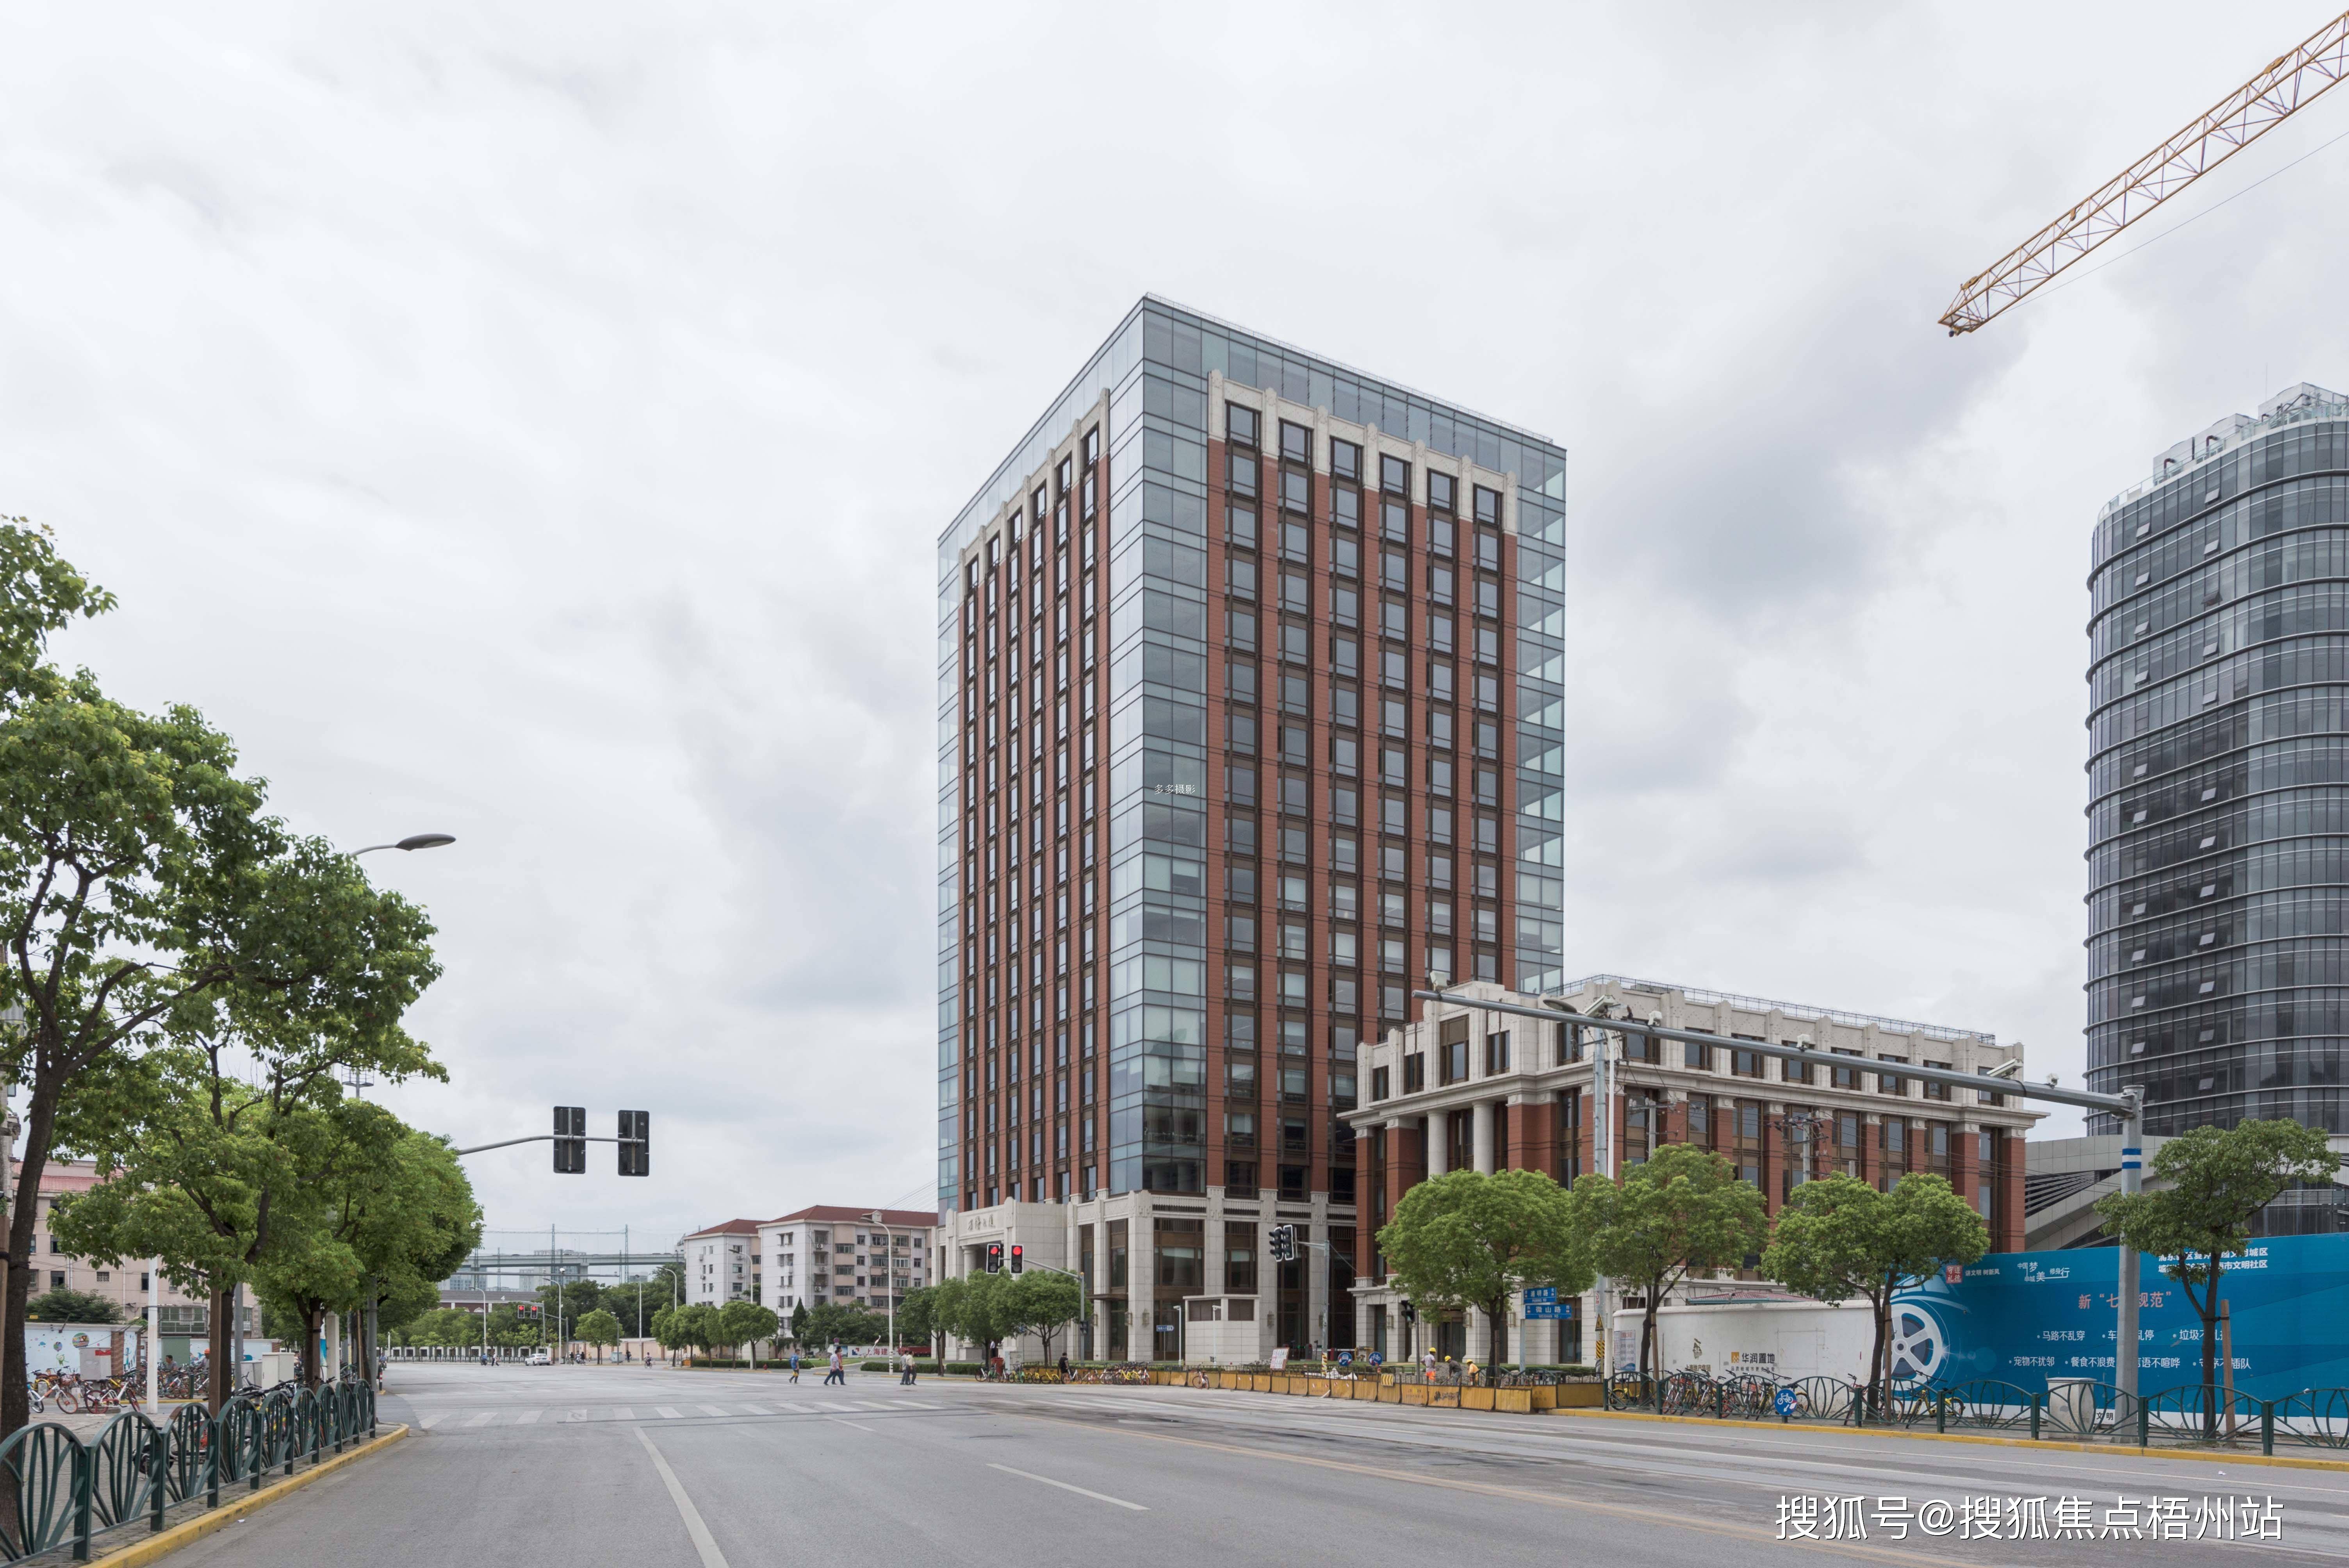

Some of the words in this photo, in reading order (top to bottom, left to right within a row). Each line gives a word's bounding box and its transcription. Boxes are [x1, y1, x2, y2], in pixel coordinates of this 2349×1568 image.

[2018, 1261, 2038, 1272] 中国梦
[2078, 1294, 2091, 1309] 新
[2042, 1330, 2085, 1341] 马路不乱穿
[1742, 1353, 1775, 1363] 华润置地
[2014, 1356, 2055, 1367] 宠物不扰邻
[2071, 1357, 2115, 1367] 餐食不浪费
[2096, 1412, 2113, 1420] 文明
